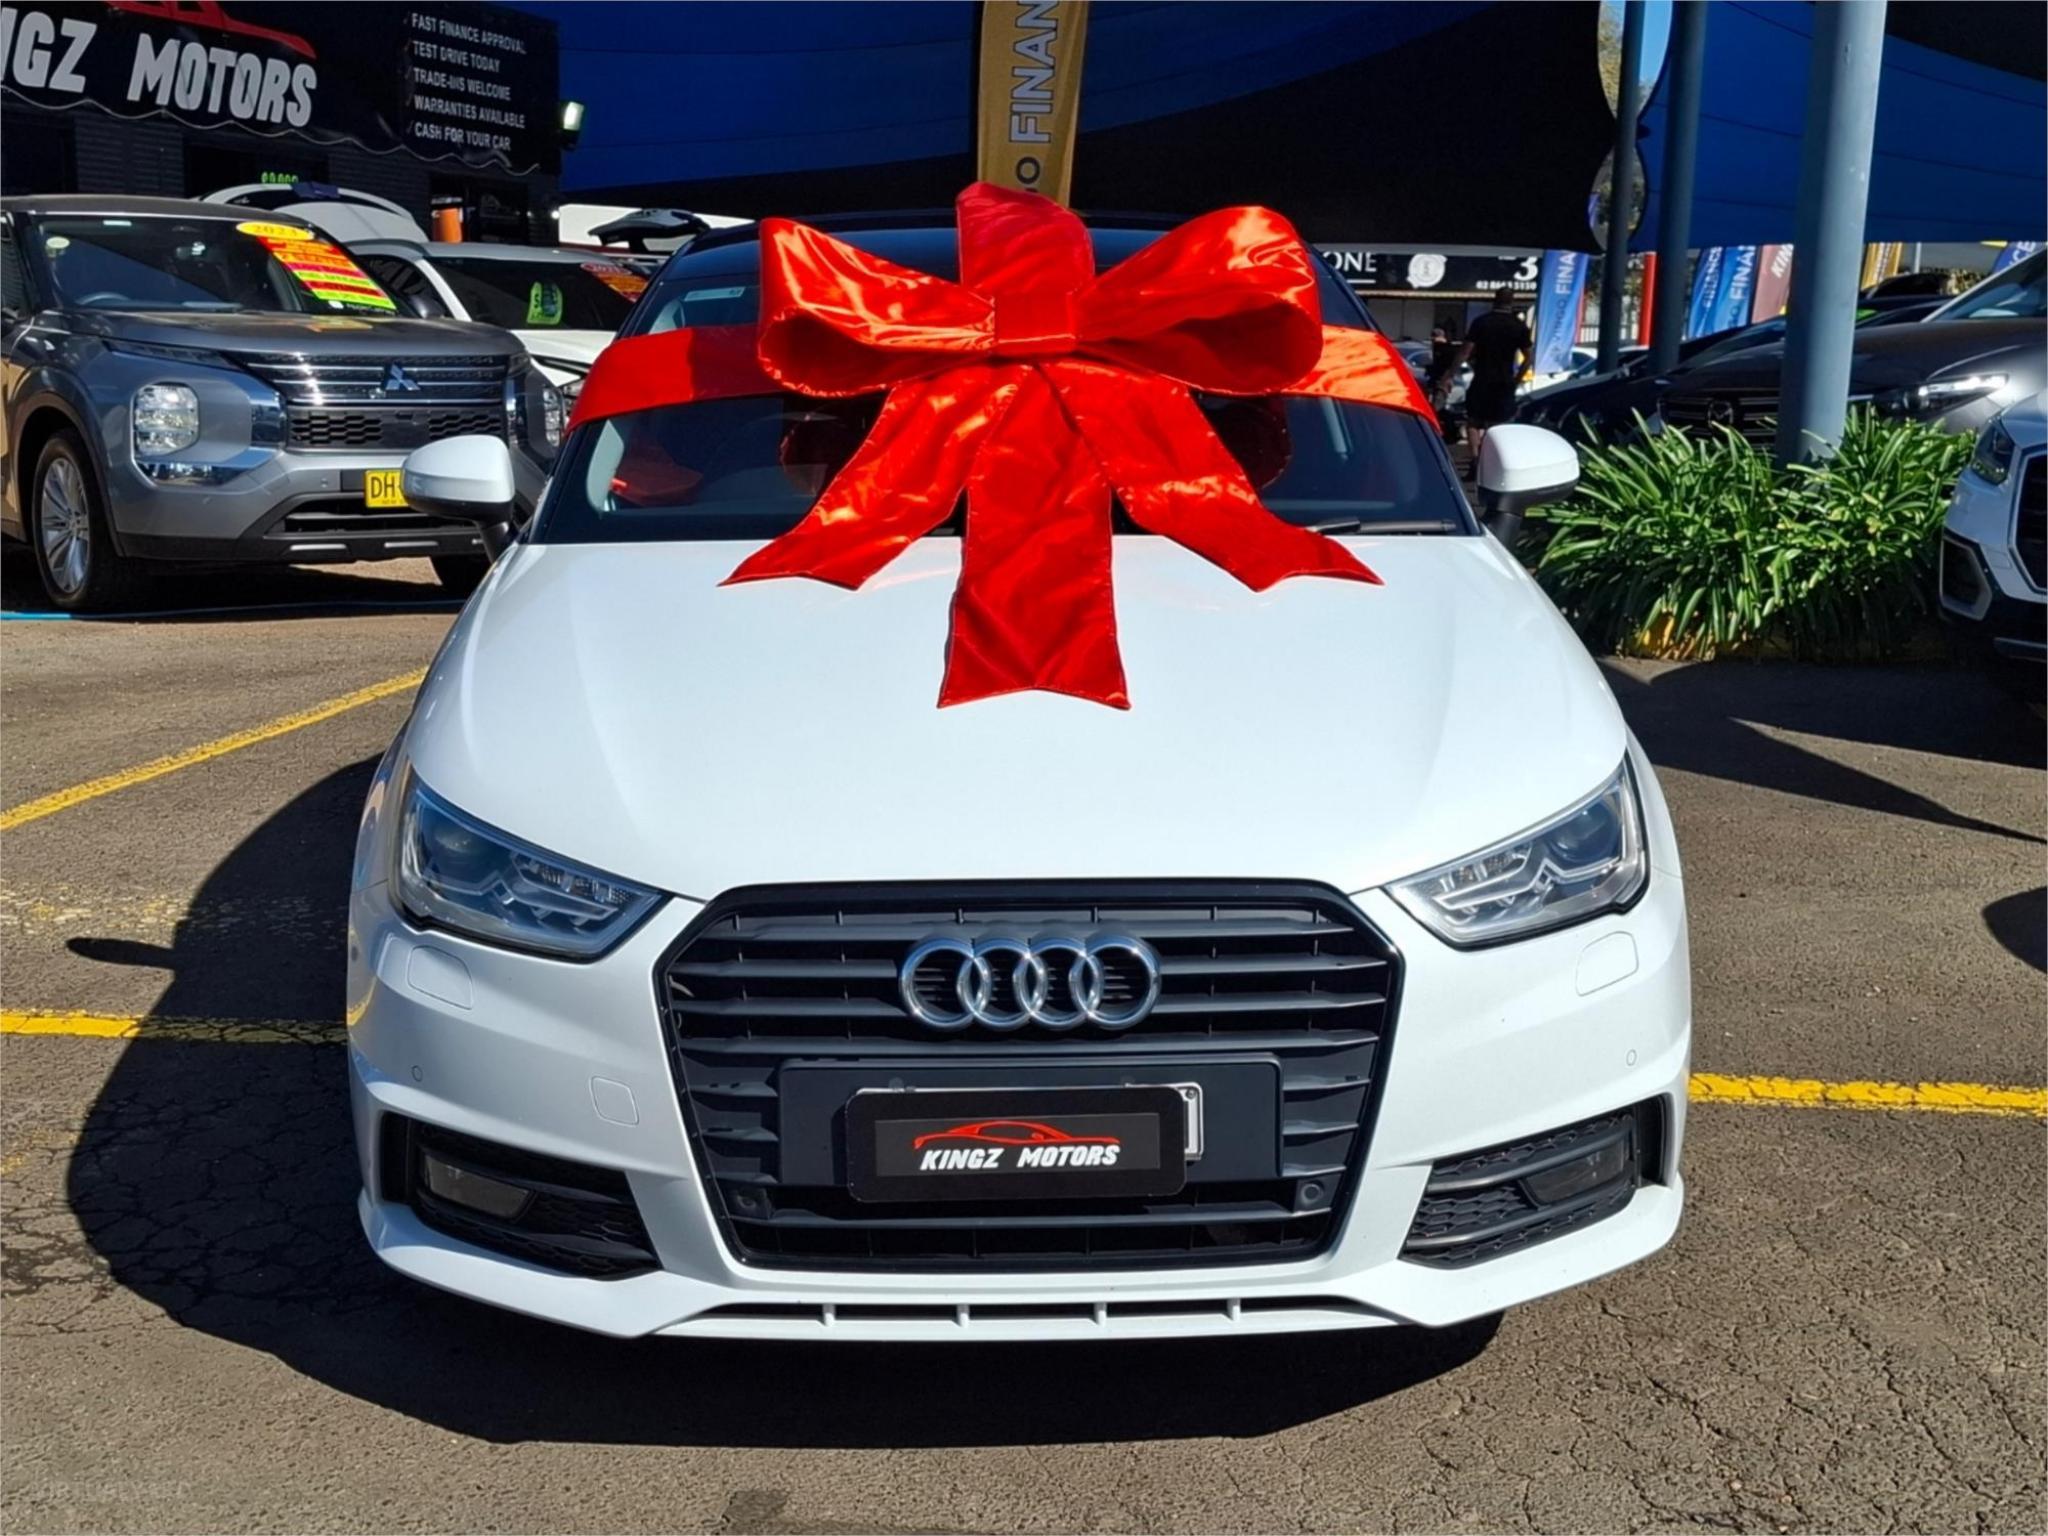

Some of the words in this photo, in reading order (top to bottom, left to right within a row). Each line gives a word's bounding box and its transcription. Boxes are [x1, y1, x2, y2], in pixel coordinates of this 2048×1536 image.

[411, 13, 437, 32] FAST
[439, 19, 480, 43] FINANCE
[481, 30, 527, 55] APPROVAL
[413, 40, 438, 59] TEST
[440, 46, 469, 67] DRIVE
[470, 53, 501, 73] TODAY
[127, 33, 317, 127] MOTORS
[413, 67, 465, 92] TRADE-INS
[466, 78, 511, 101] WELCOME
[414, 95, 477, 120] WARRANTIES
[478, 107, 526, 129] AVAILABLE
[414, 122, 442, 140] CASH
[444, 126, 464, 143] FOR
[465, 130, 491, 148] YOUR
[492, 135, 511, 151] CAR
[920, 1148, 1005, 1171] KINGZ
[1016, 1145, 1121, 1169] MOTORS
